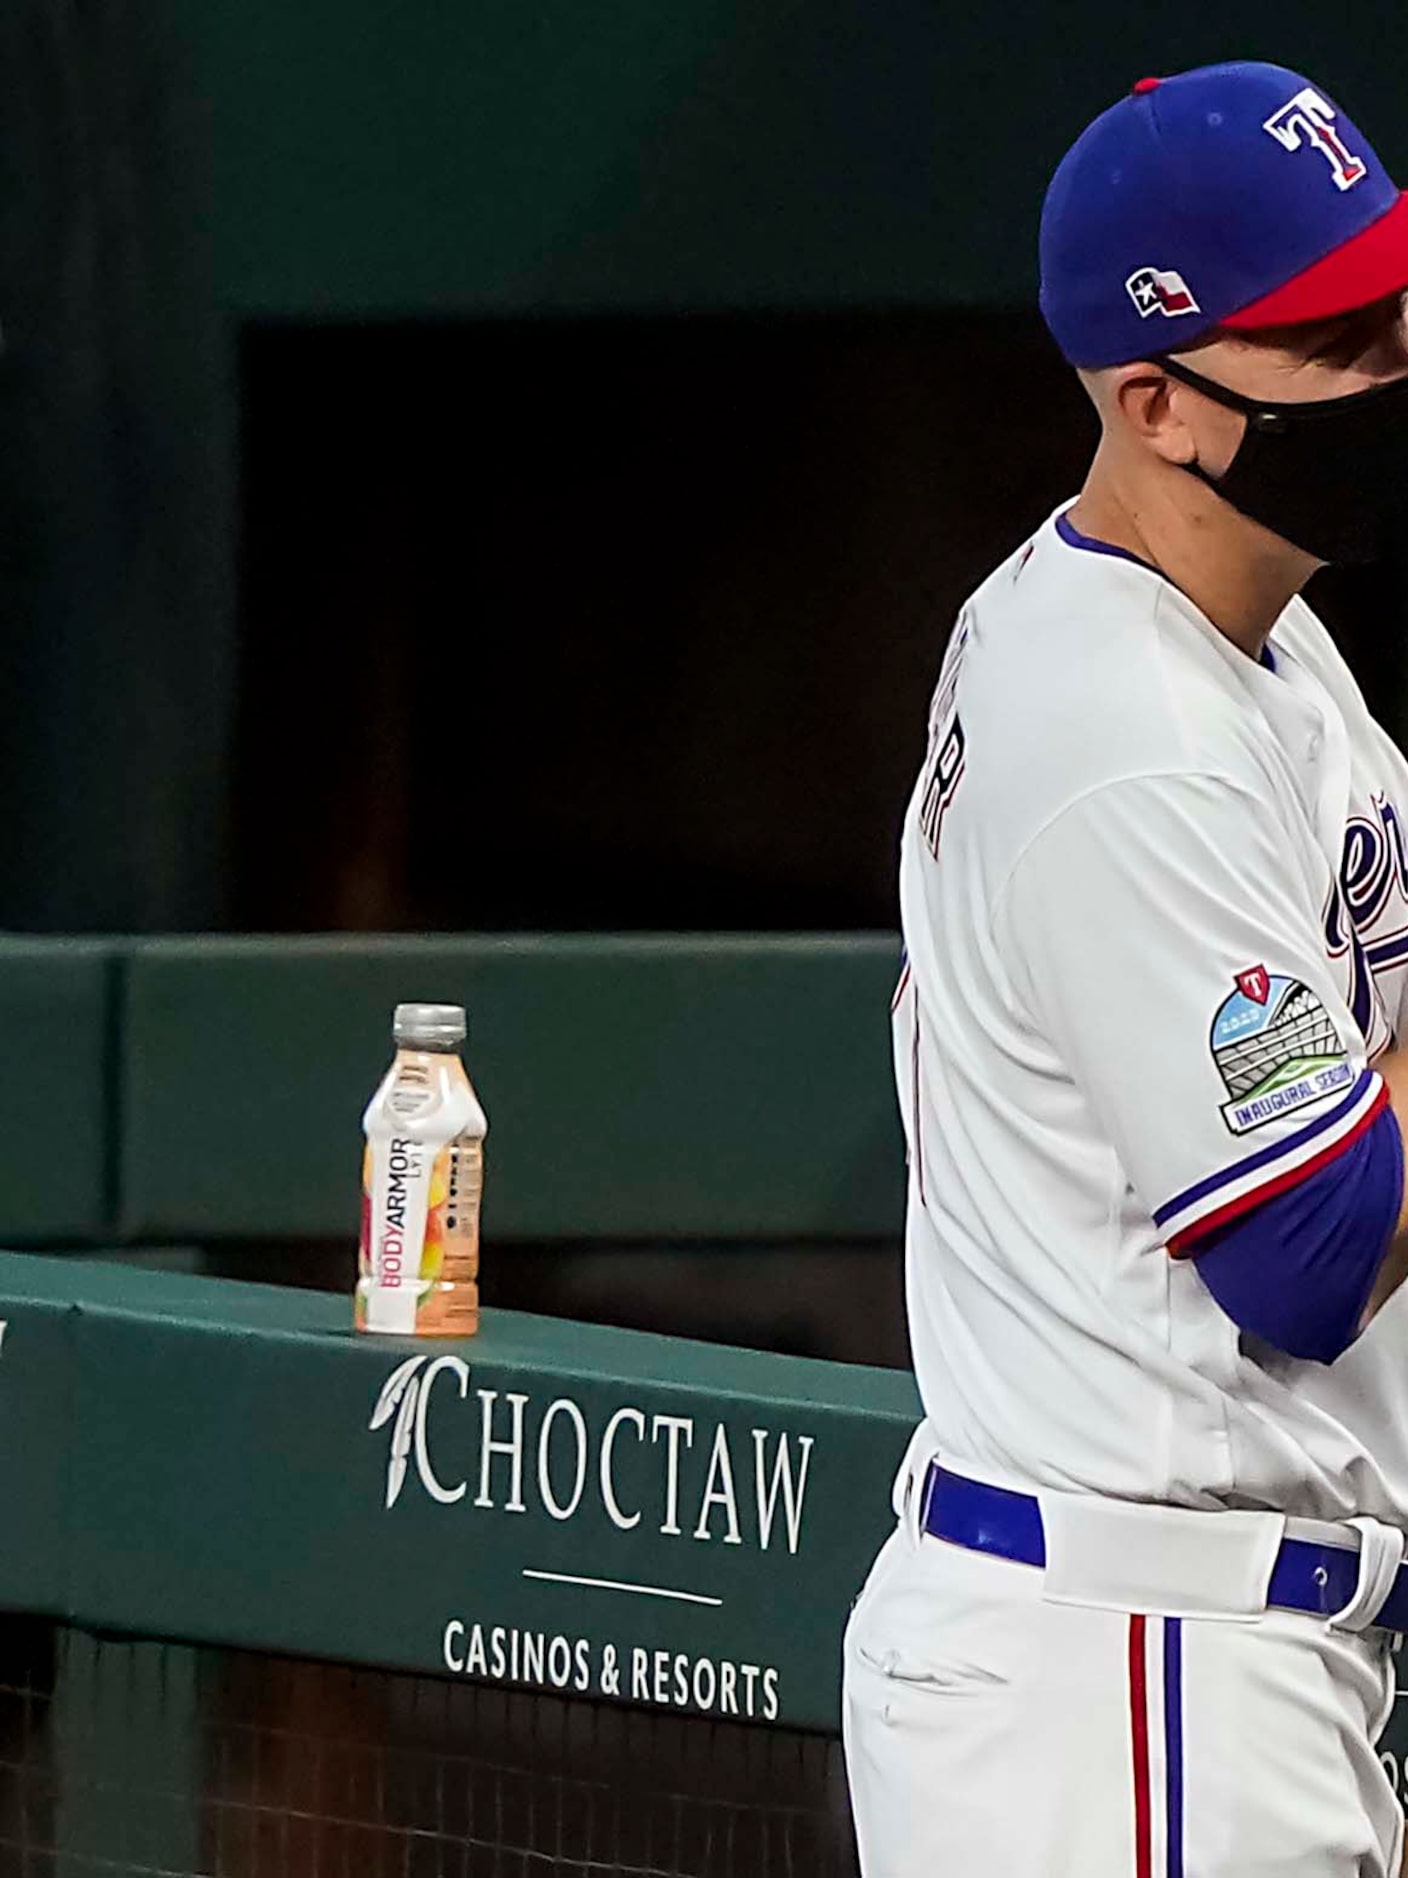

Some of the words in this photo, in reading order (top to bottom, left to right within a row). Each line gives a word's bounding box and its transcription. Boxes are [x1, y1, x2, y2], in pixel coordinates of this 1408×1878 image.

[1262, 88, 1367, 191] T
[1244, 972, 1262, 998] T
[1234, 1081, 1317, 1127] INAUGURAL
[379, 1137, 411, 1288] BODYARMOR
[414, 1353, 815, 1556] CHOCTAW
[443, 1620, 590, 1692] CASINOS
[600, 1642, 622, 1696] &
[632, 1647, 781, 1721] RESORTS
